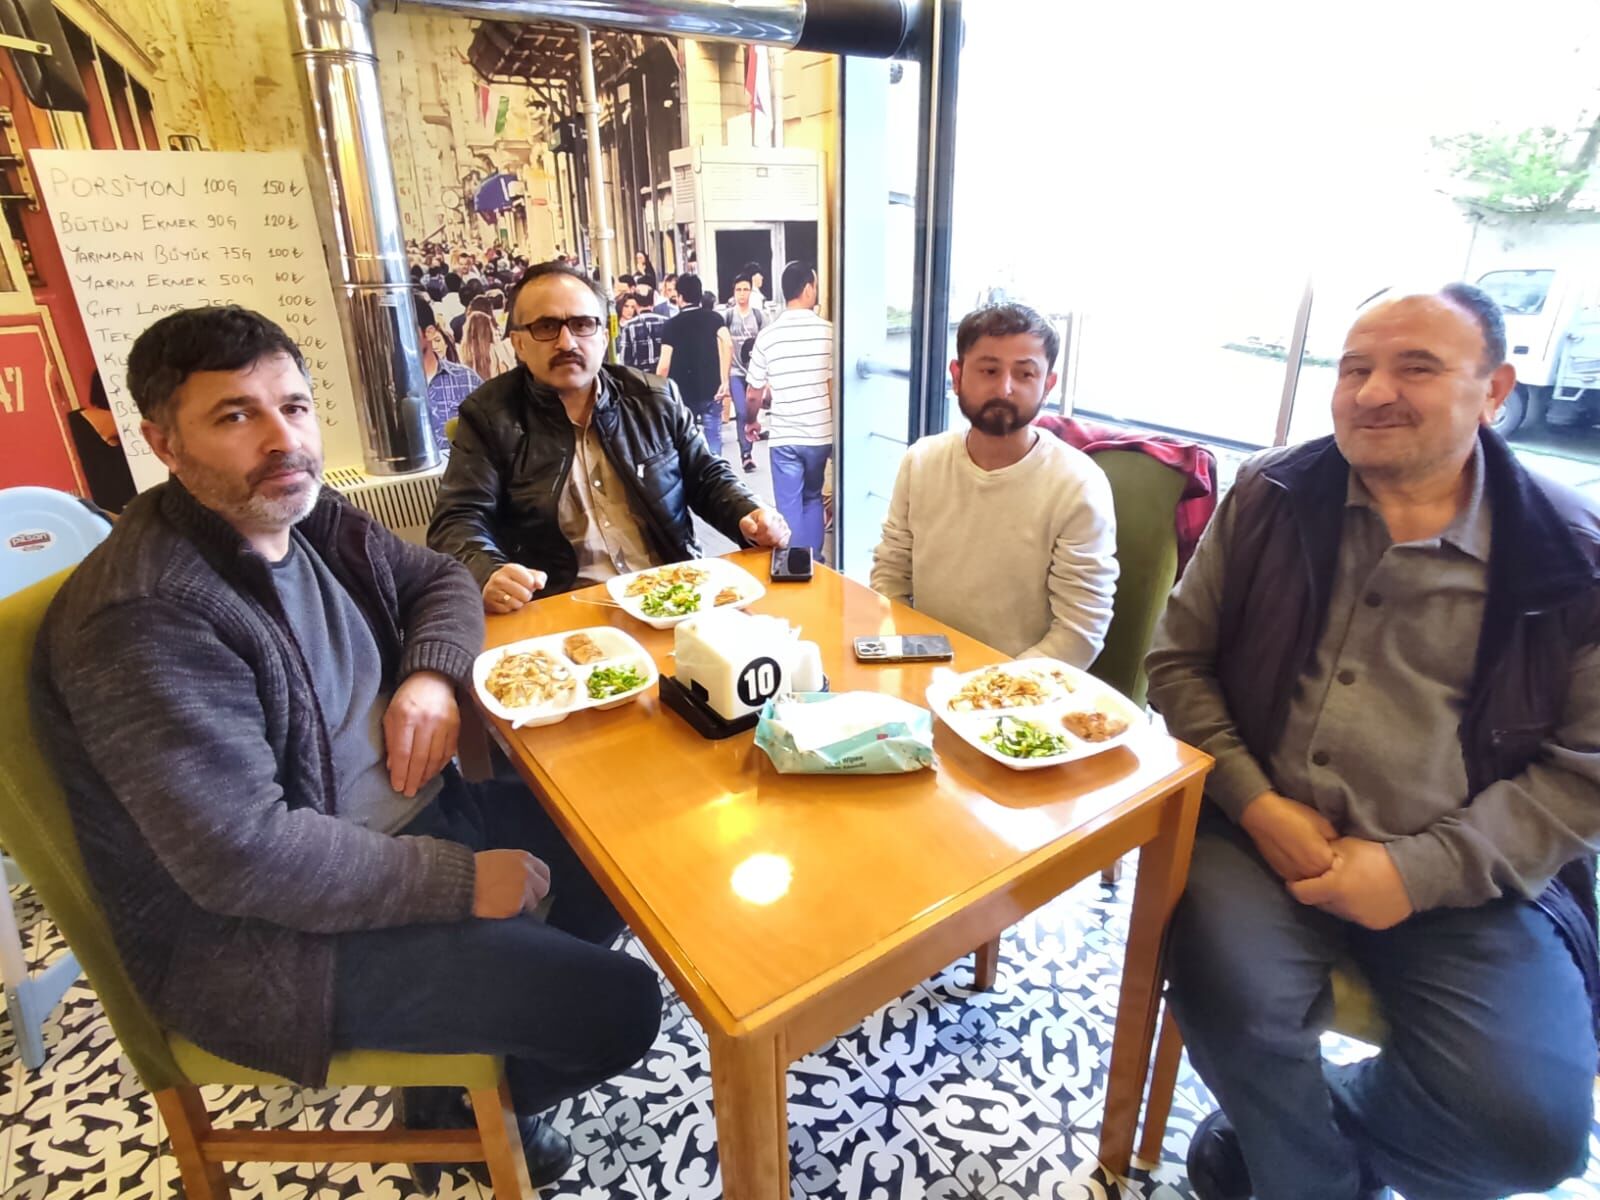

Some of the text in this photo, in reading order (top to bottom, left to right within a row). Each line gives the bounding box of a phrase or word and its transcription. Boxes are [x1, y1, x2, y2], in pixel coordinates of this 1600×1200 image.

[204, 178, 237, 196] 100G
[60, 211, 128, 234] BÜTÜN
[142, 214, 199, 231] EKMEK
[207, 214, 237, 230] 90G
[66, 245, 144, 264] YARIMDAN
[155, 244, 209, 265] BÜYÜK
[219, 246, 251, 261] 75G
[76, 275, 135, 291] YARIM
[147, 274, 207, 288] EKMEK
[220, 274, 253, 286] 50G
[743, 663, 775, 701] 10
